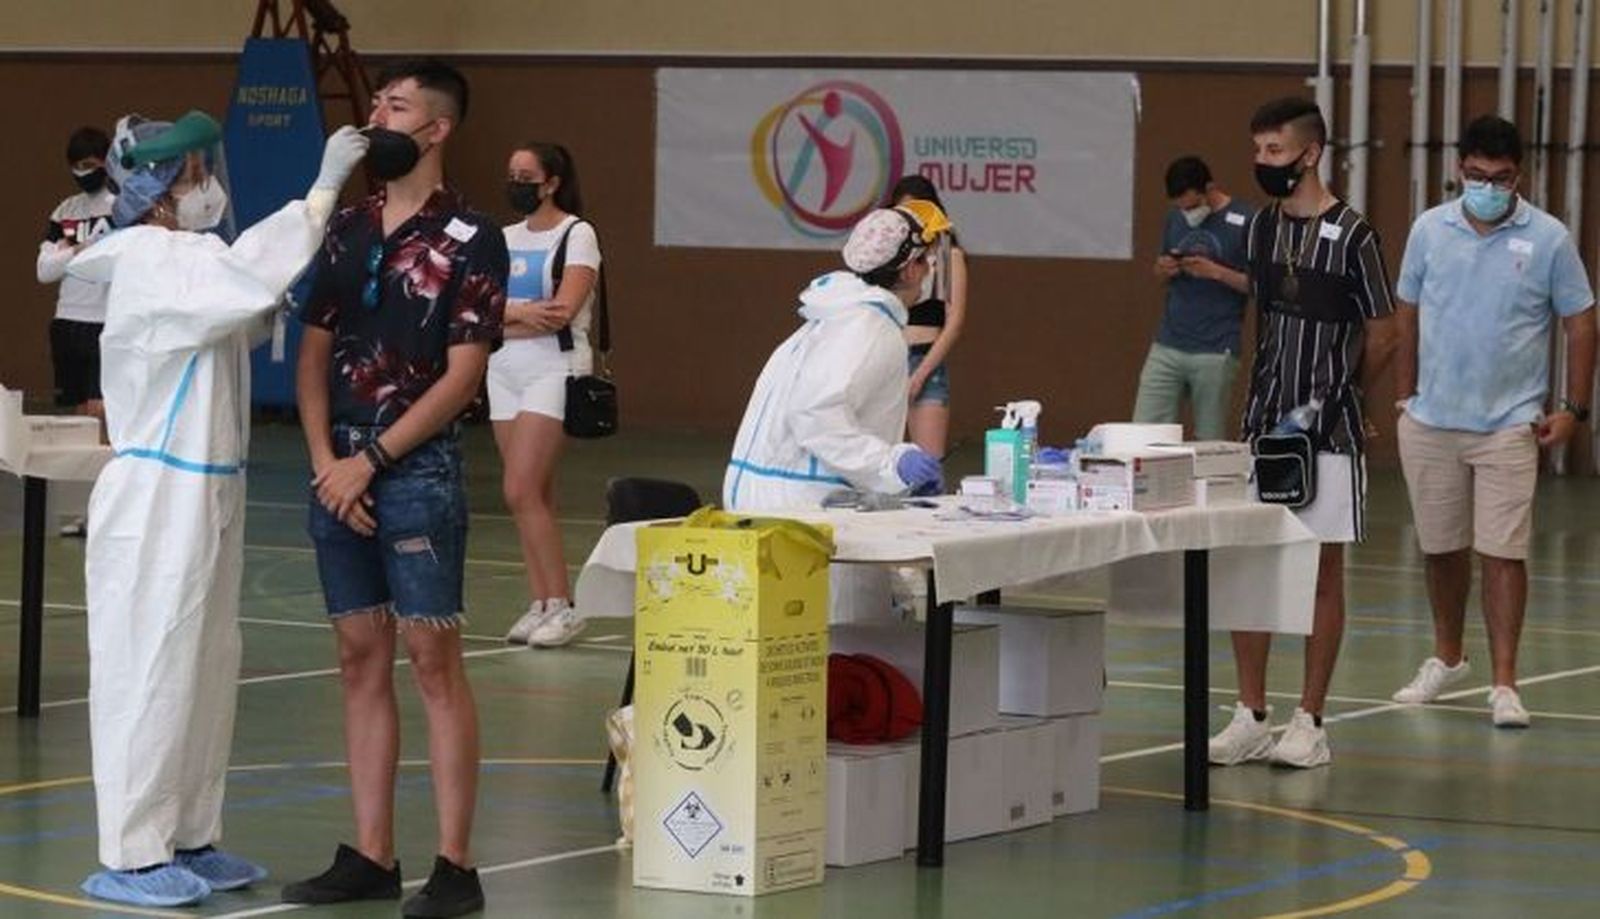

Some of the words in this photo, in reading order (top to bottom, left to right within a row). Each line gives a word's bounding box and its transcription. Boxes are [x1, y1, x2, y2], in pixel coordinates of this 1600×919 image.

[237, 87, 307, 106] NOSHAGA
[247, 113, 291, 128] SPORT
[914, 137, 1037, 159] UNIVERSO
[919, 162, 1036, 193] MUJER
